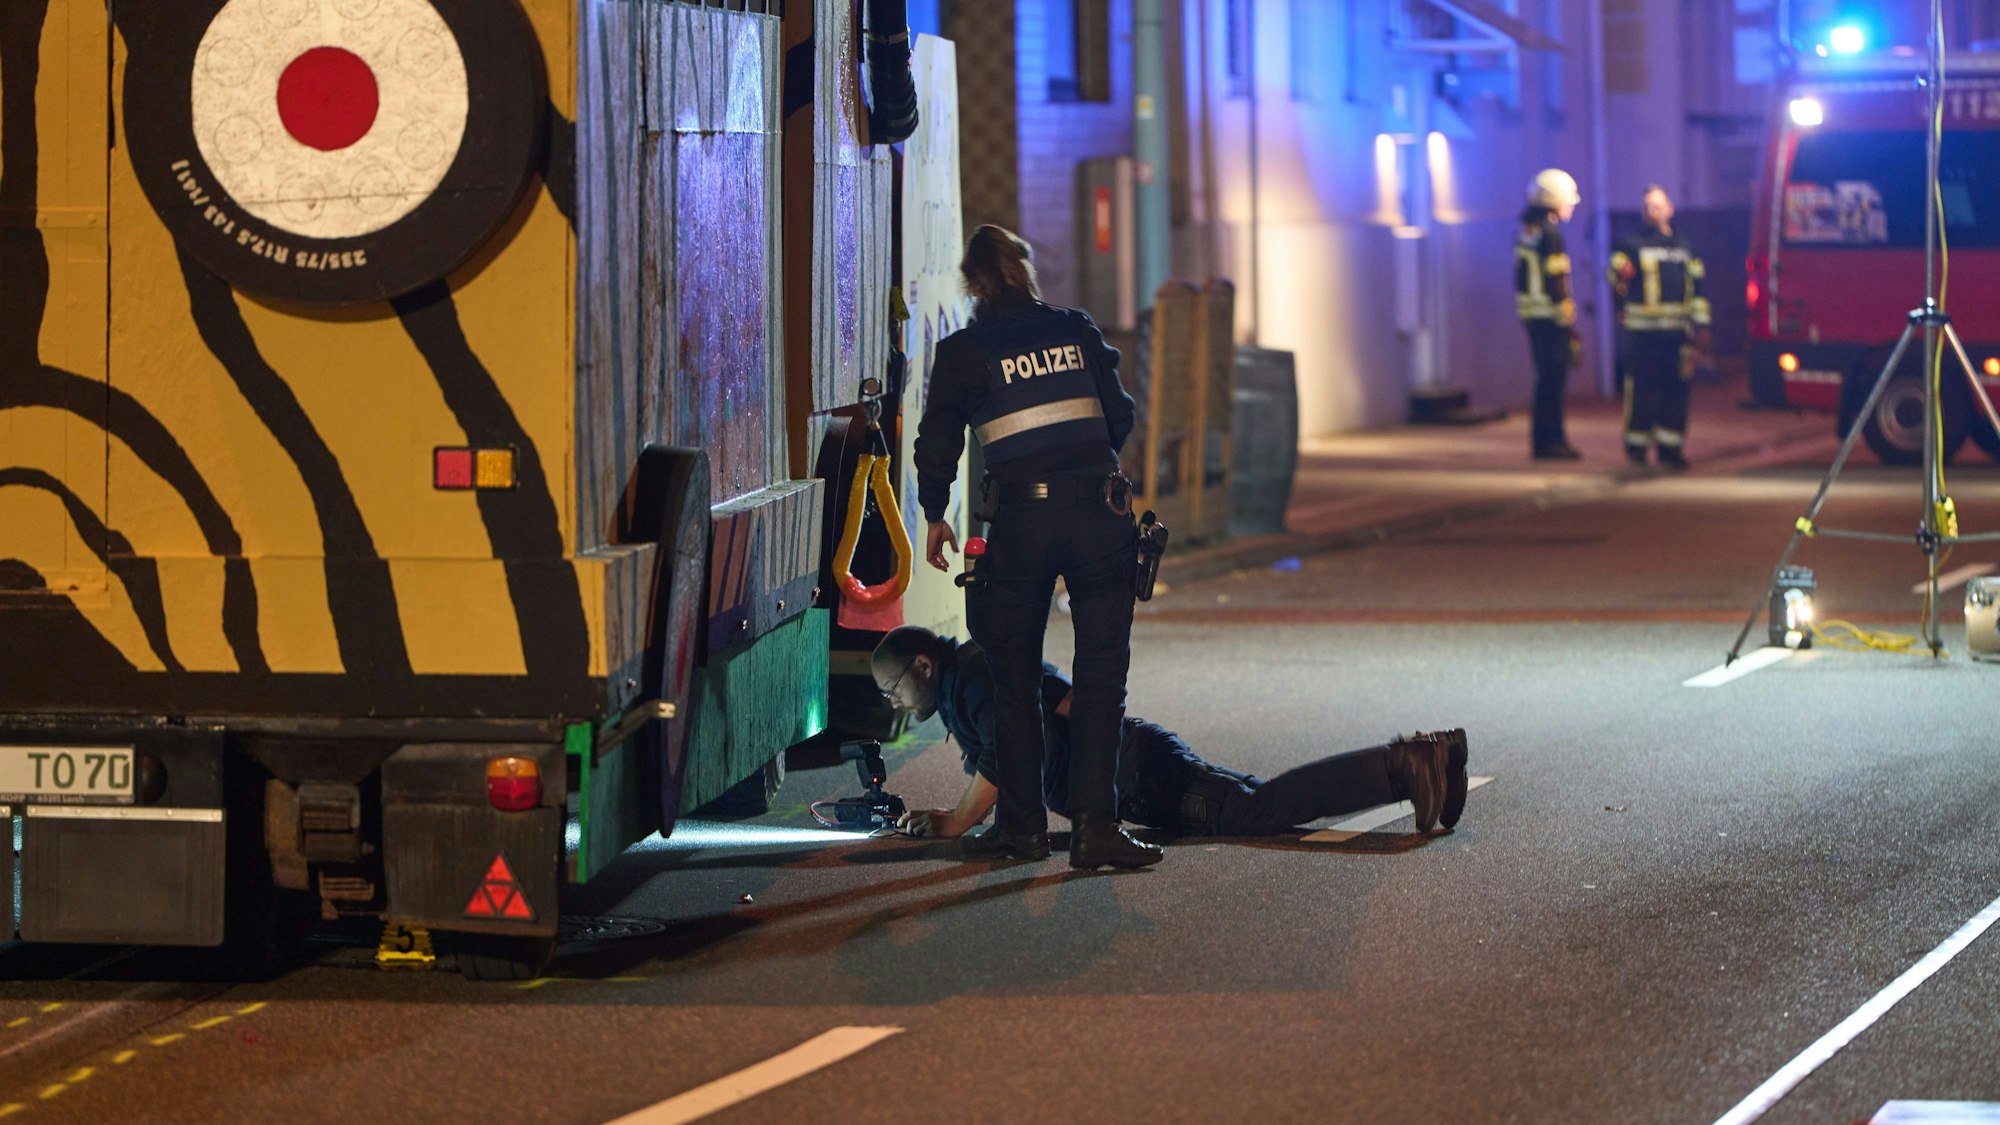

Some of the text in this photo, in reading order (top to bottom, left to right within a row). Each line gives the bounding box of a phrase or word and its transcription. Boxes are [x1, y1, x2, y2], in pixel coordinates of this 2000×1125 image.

[1000, 345, 1085, 384] POLIZEI
[27, 752, 130, 789] TO 70
[397, 925, 415, 954] 5
